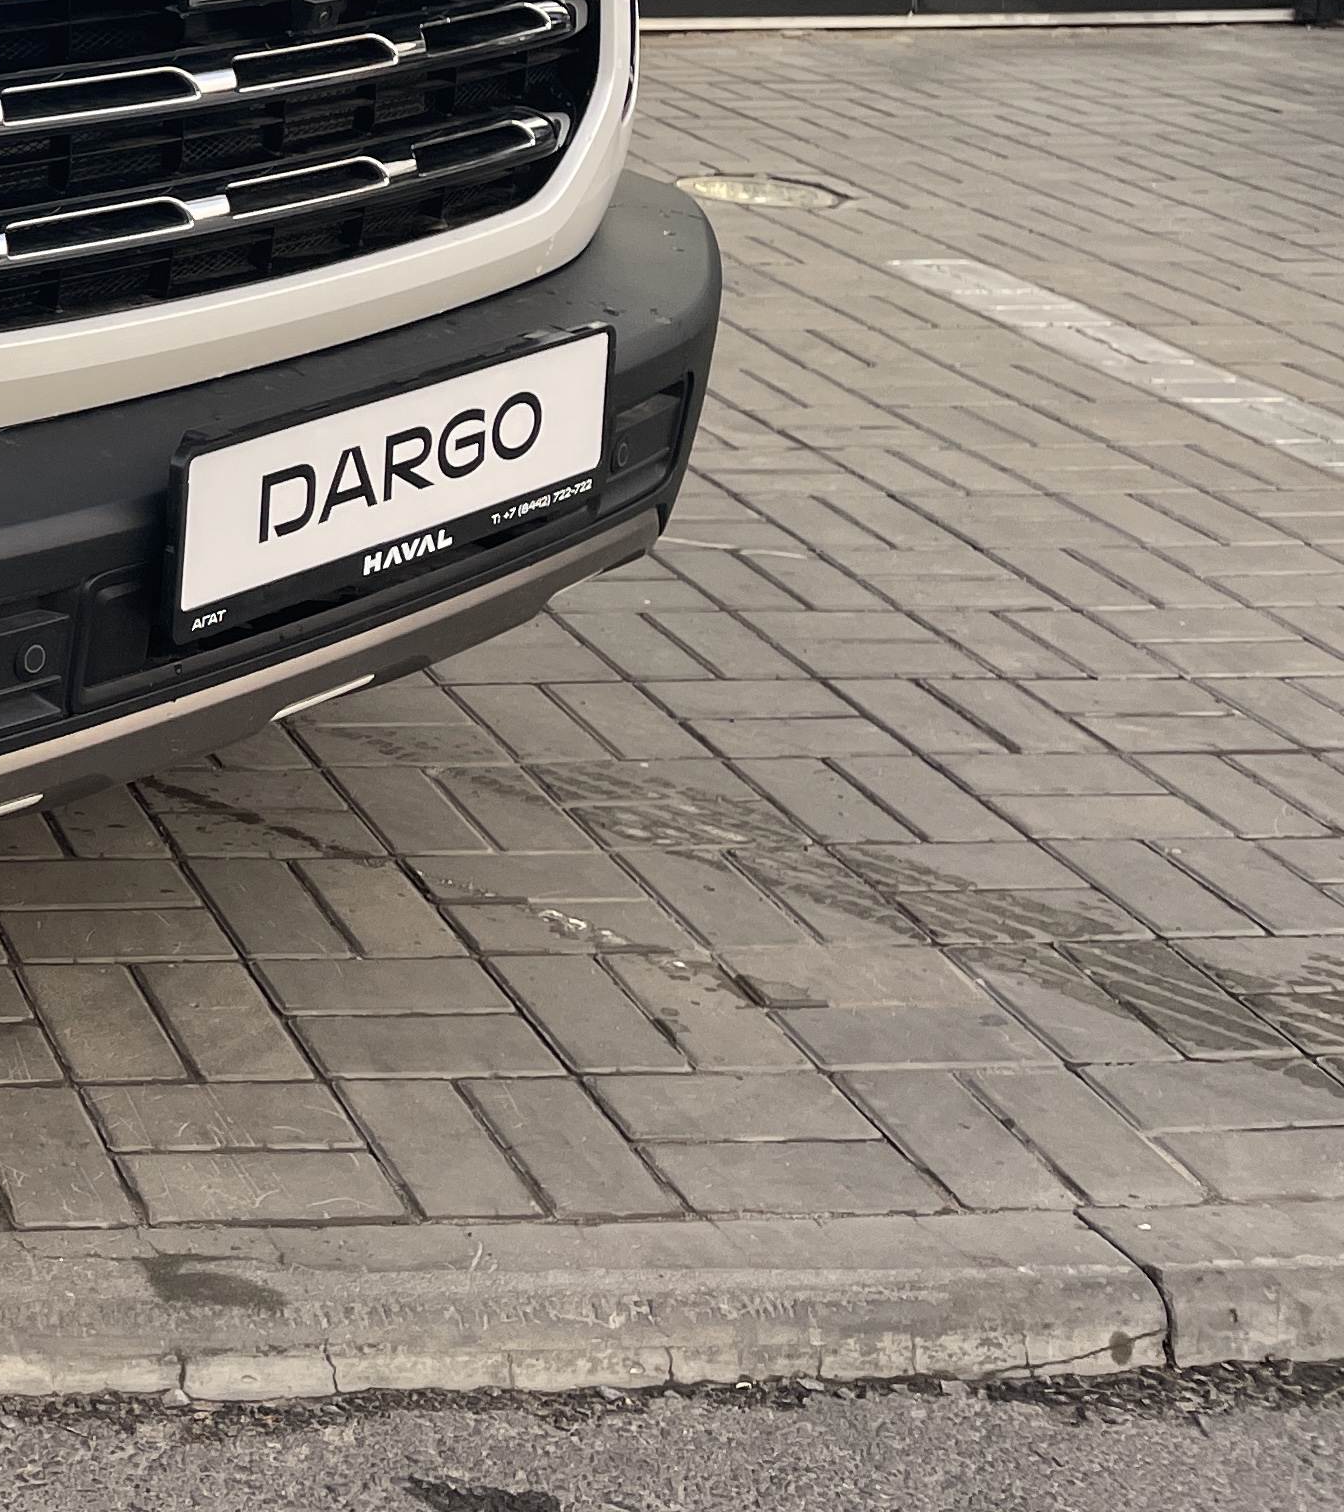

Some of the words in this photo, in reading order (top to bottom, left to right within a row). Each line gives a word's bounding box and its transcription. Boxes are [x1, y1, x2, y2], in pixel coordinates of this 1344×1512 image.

[258, 391, 542, 544] DARGO
[503, 506, 517, 520] +7
[517, 494, 551, 517] (8442)
[552, 478, 593, 503] 722-722
[362, 527, 454, 576] HAVAL
[191, 609, 227, 632] АГАТ
